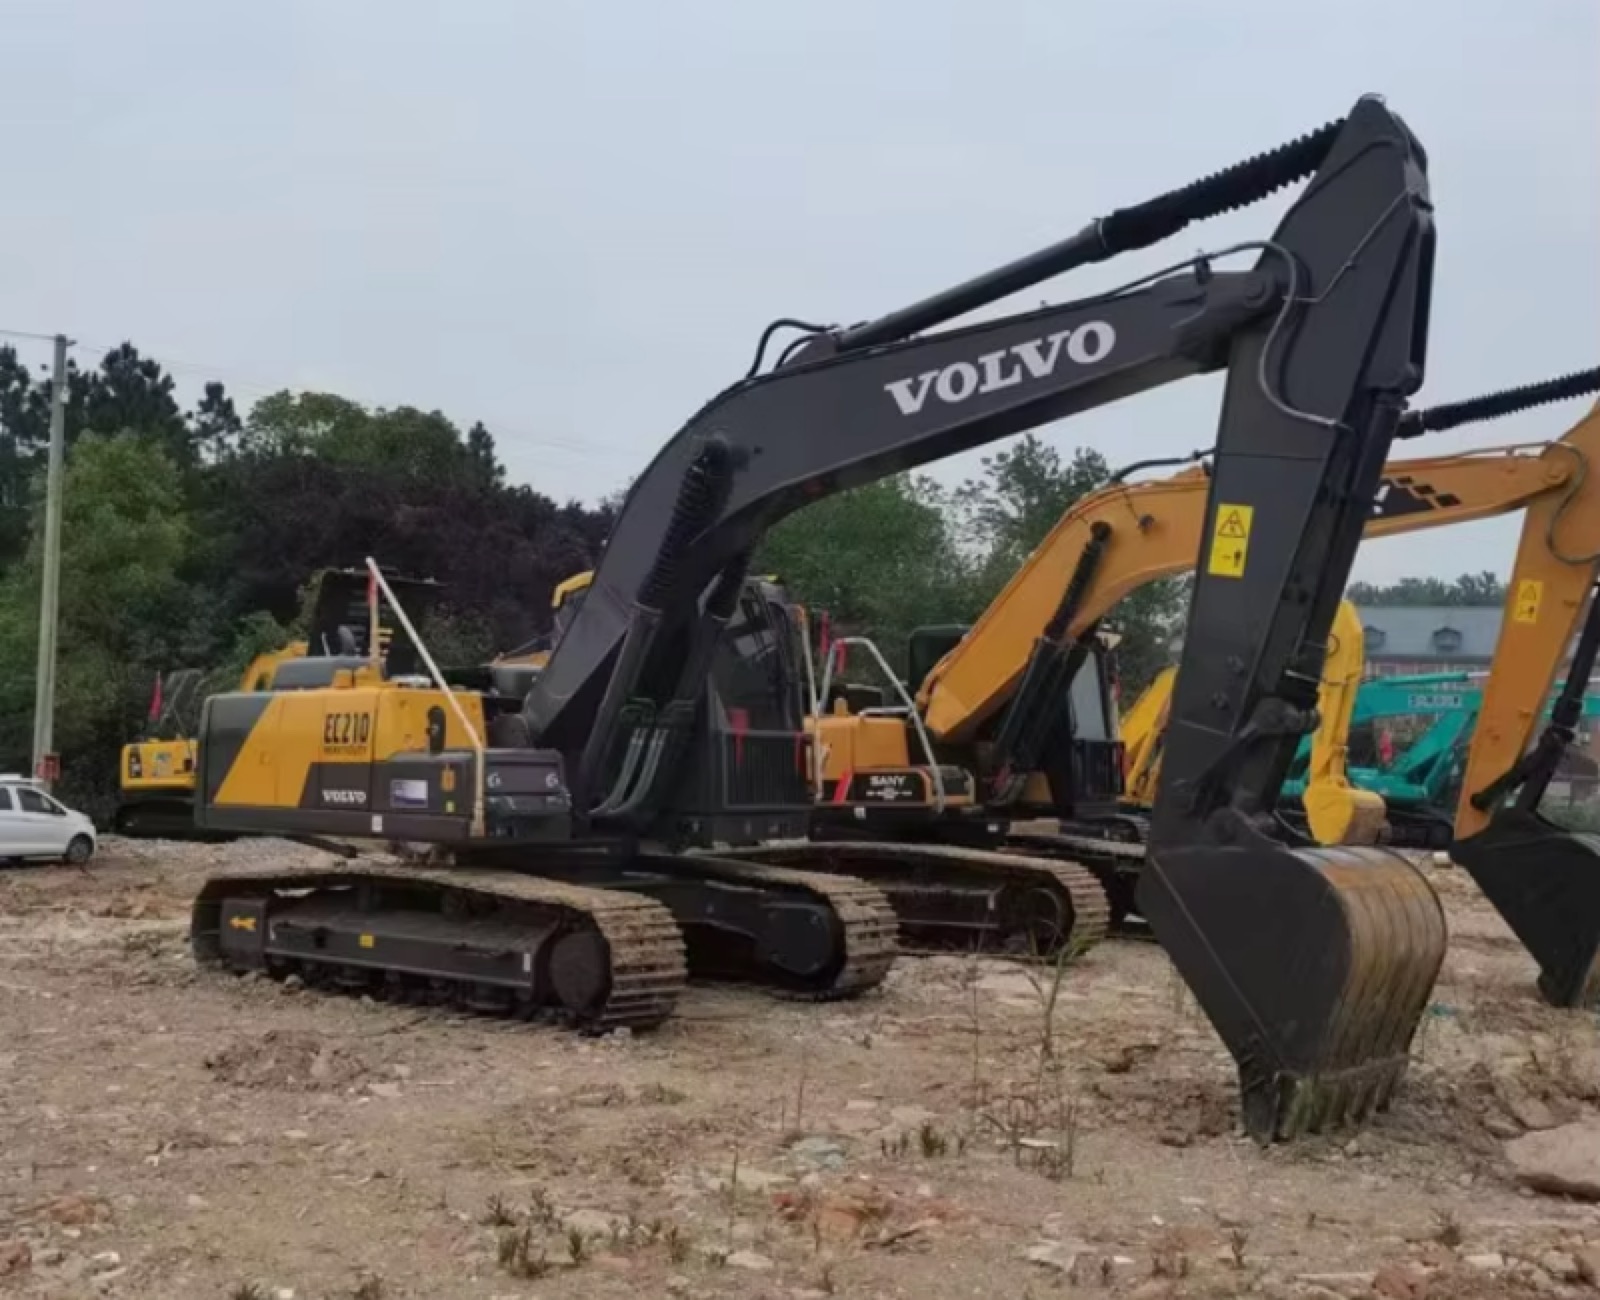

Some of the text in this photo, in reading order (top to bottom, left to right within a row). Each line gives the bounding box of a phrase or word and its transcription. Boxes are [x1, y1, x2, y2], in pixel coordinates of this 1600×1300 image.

[884, 320, 1116, 415] VOLVO
[324, 713, 370, 744] EC210
[870, 775, 906, 787] SANY
[322, 789, 367, 804] VOLVO
